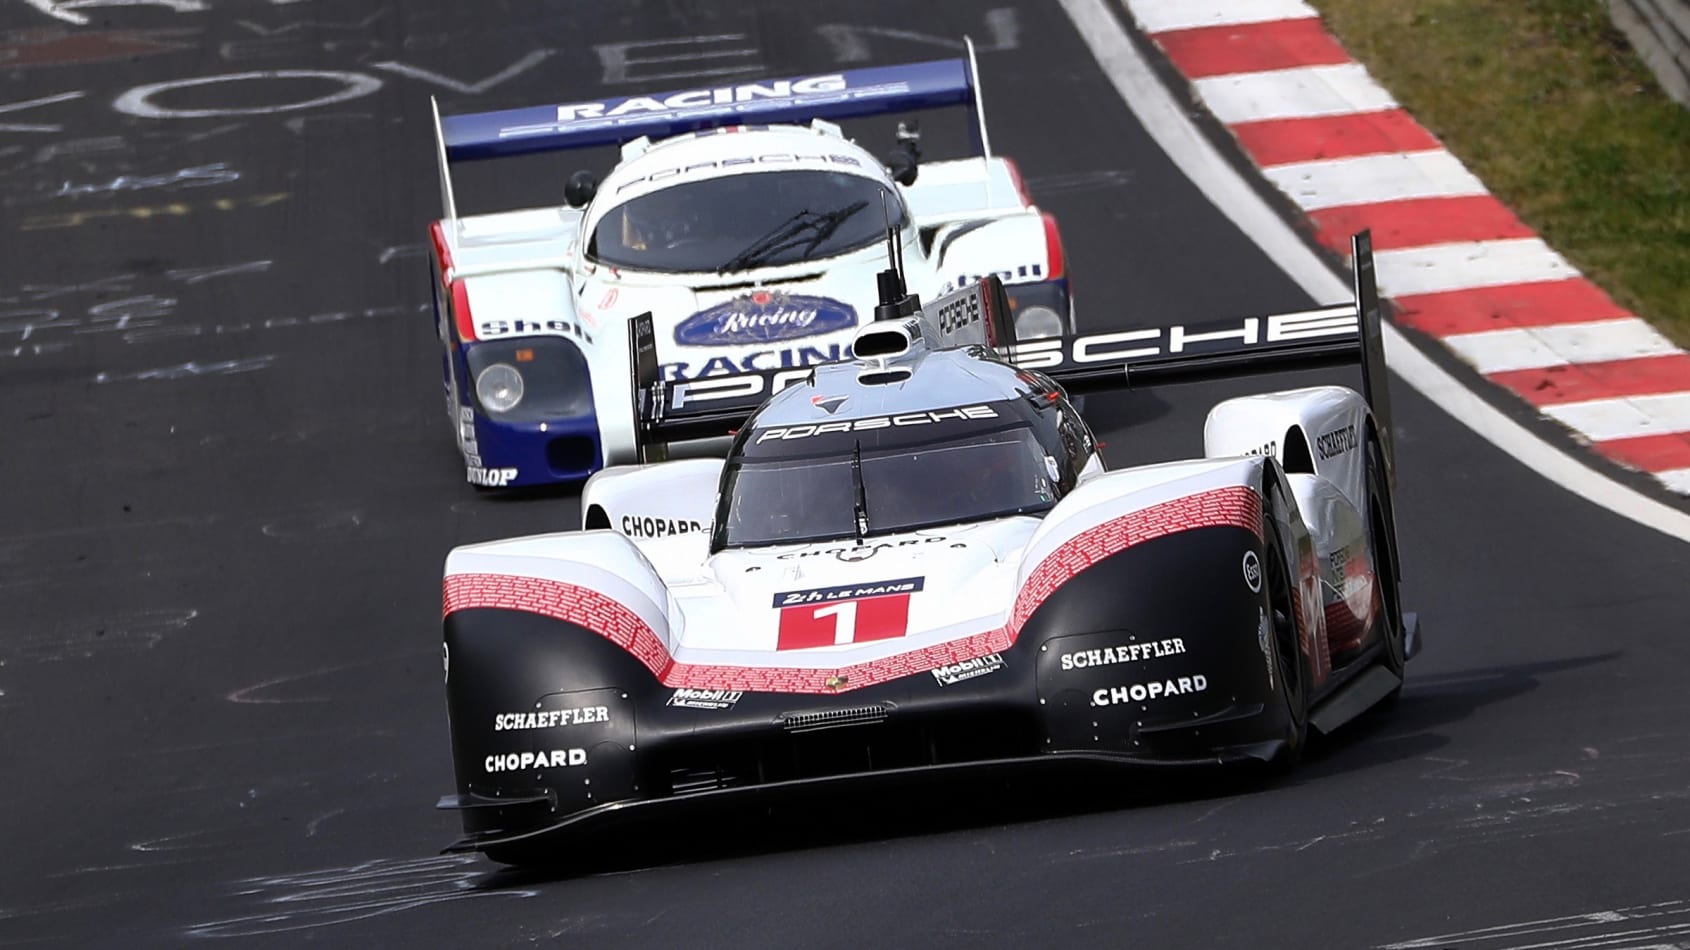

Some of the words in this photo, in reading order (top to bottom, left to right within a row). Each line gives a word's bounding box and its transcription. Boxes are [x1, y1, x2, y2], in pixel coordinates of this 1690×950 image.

[556, 74, 846, 121] RACING
[713, 306, 817, 334] Racing
[938, 292, 980, 337] PORSCHE
[658, 344, 852, 382] RACIN
[756, 405, 999, 444] PORSCHE
[467, 466, 518, 486] DUNLOP
[621, 515, 702, 538] CHOPARD
[826, 590, 853, 600] LE
[855, 583, 915, 597] MANS
[813, 600, 858, 645] 1
[1060, 637, 1187, 670] SCHAEFFLER
[931, 658, 984, 679] Mobil
[673, 688, 726, 701] Mobil
[1092, 674, 1208, 707] CHOPARD
[495, 706, 610, 731] SCHAEFFLER
[484, 748, 587, 773] CHOPARD
